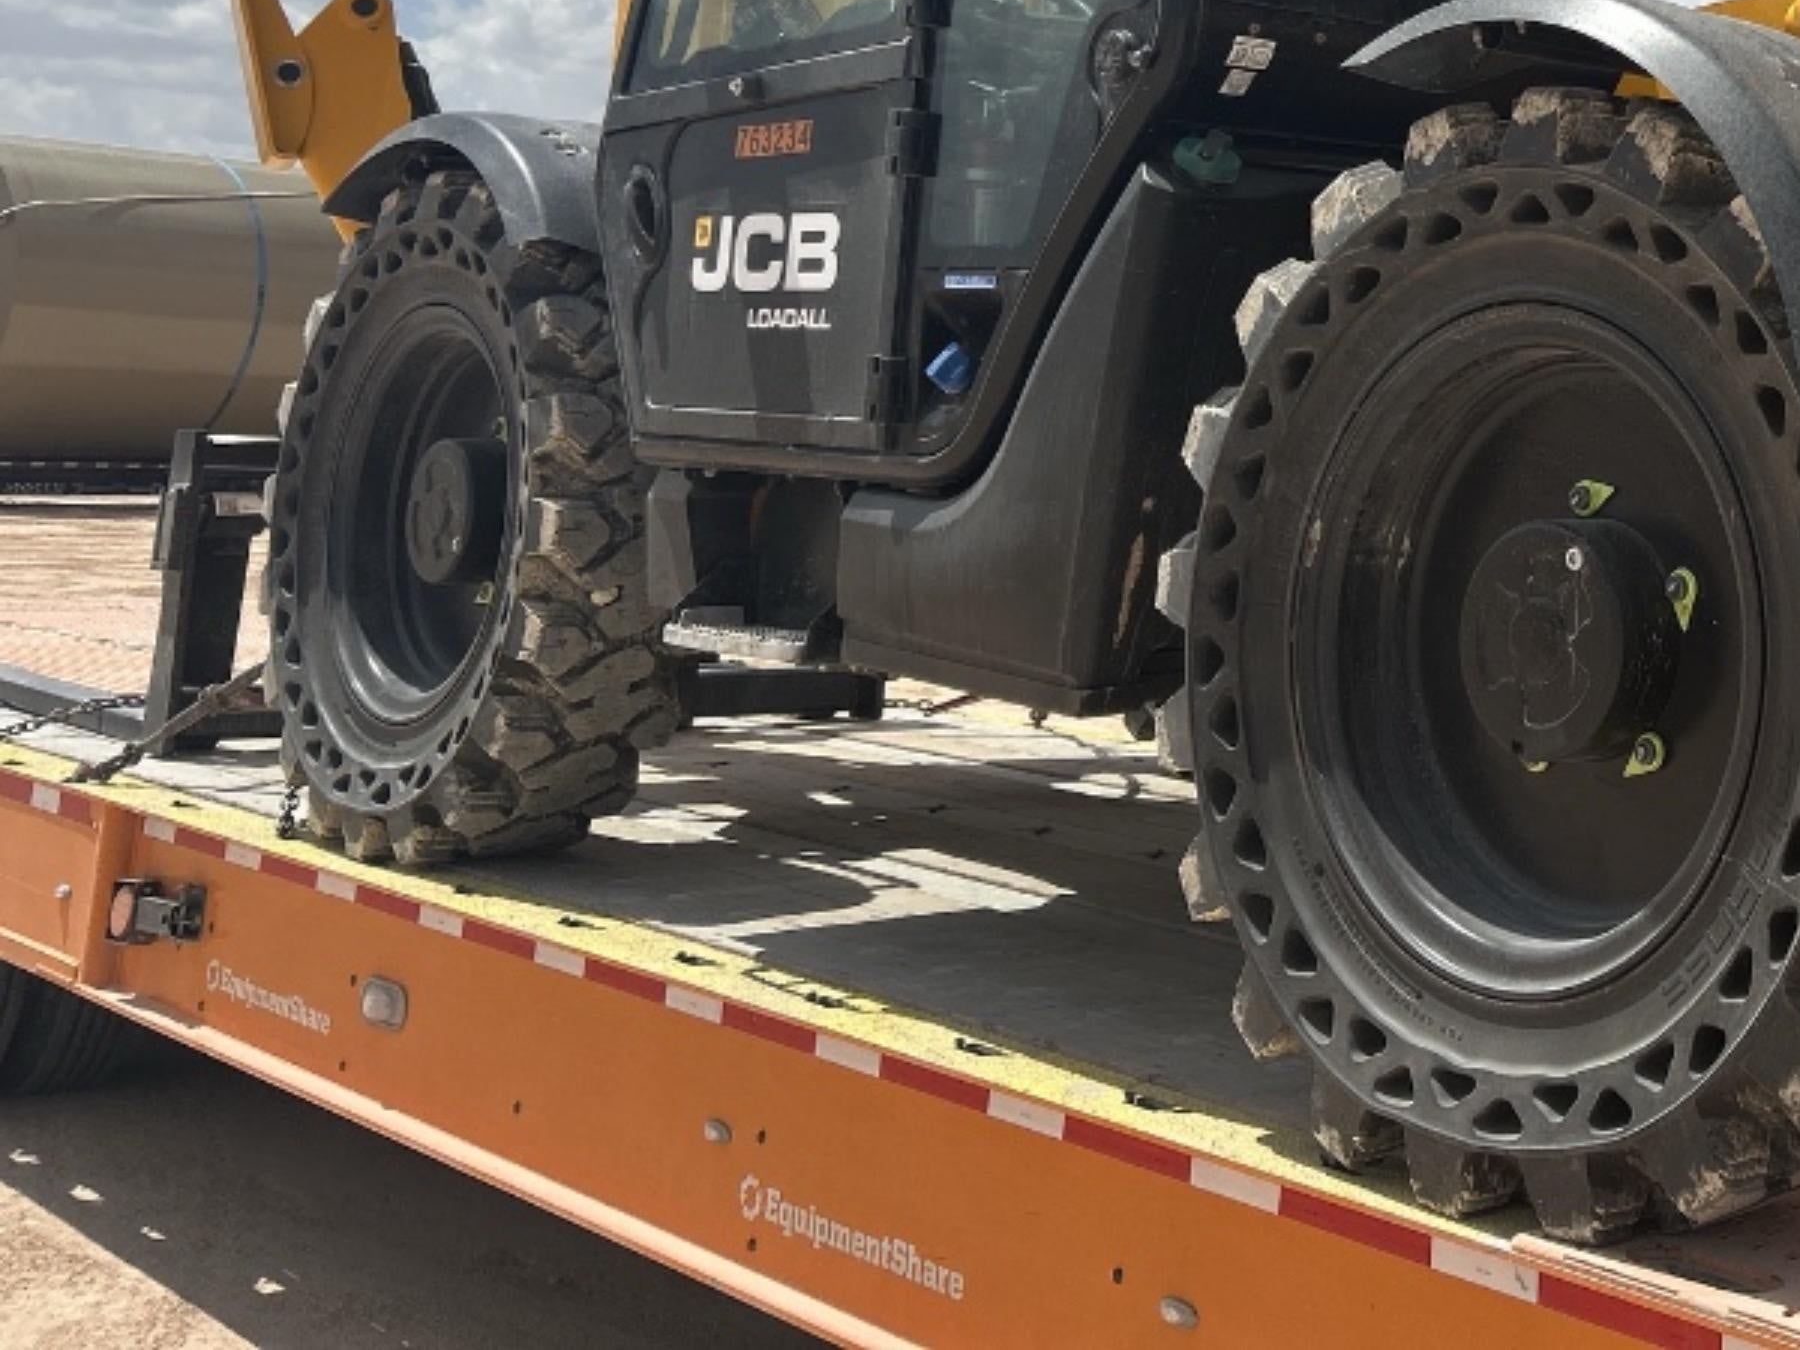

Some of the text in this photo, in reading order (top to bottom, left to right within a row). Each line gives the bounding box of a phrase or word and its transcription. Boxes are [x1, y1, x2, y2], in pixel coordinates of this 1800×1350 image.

[691, 212, 841, 292] JCB
[746, 308, 832, 329] LOADALL
[765, 1187, 965, 1301] EquipmentShare
